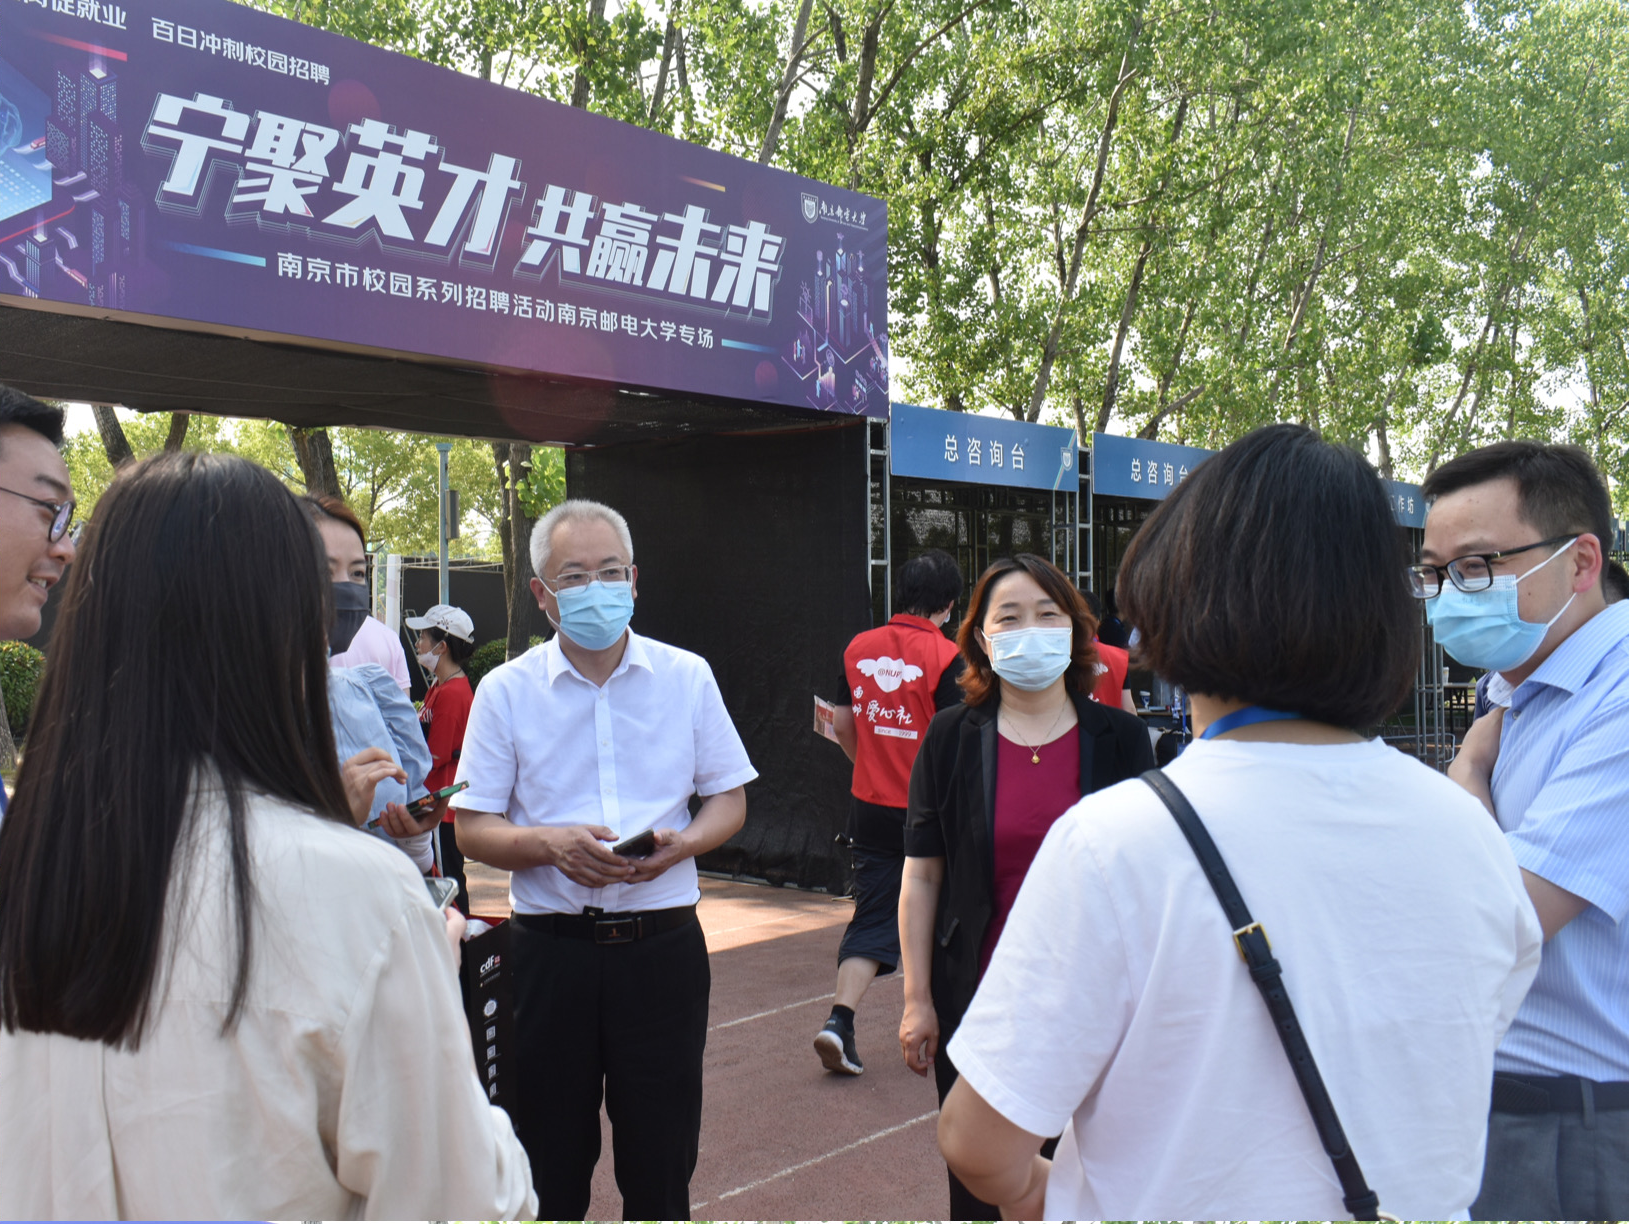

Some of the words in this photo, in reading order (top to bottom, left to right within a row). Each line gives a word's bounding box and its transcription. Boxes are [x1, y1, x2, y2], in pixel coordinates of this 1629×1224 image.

[152, 17, 330, 86] 百日冲刺校园招聘
[145, 92, 524, 258] 宁聚英才
[521, 183, 785, 314] 共赢未来
[276, 251, 716, 351] 南京市校园系列招聘活动南京邮电大学专场
[944, 434, 1025, 471] 总咨询台
